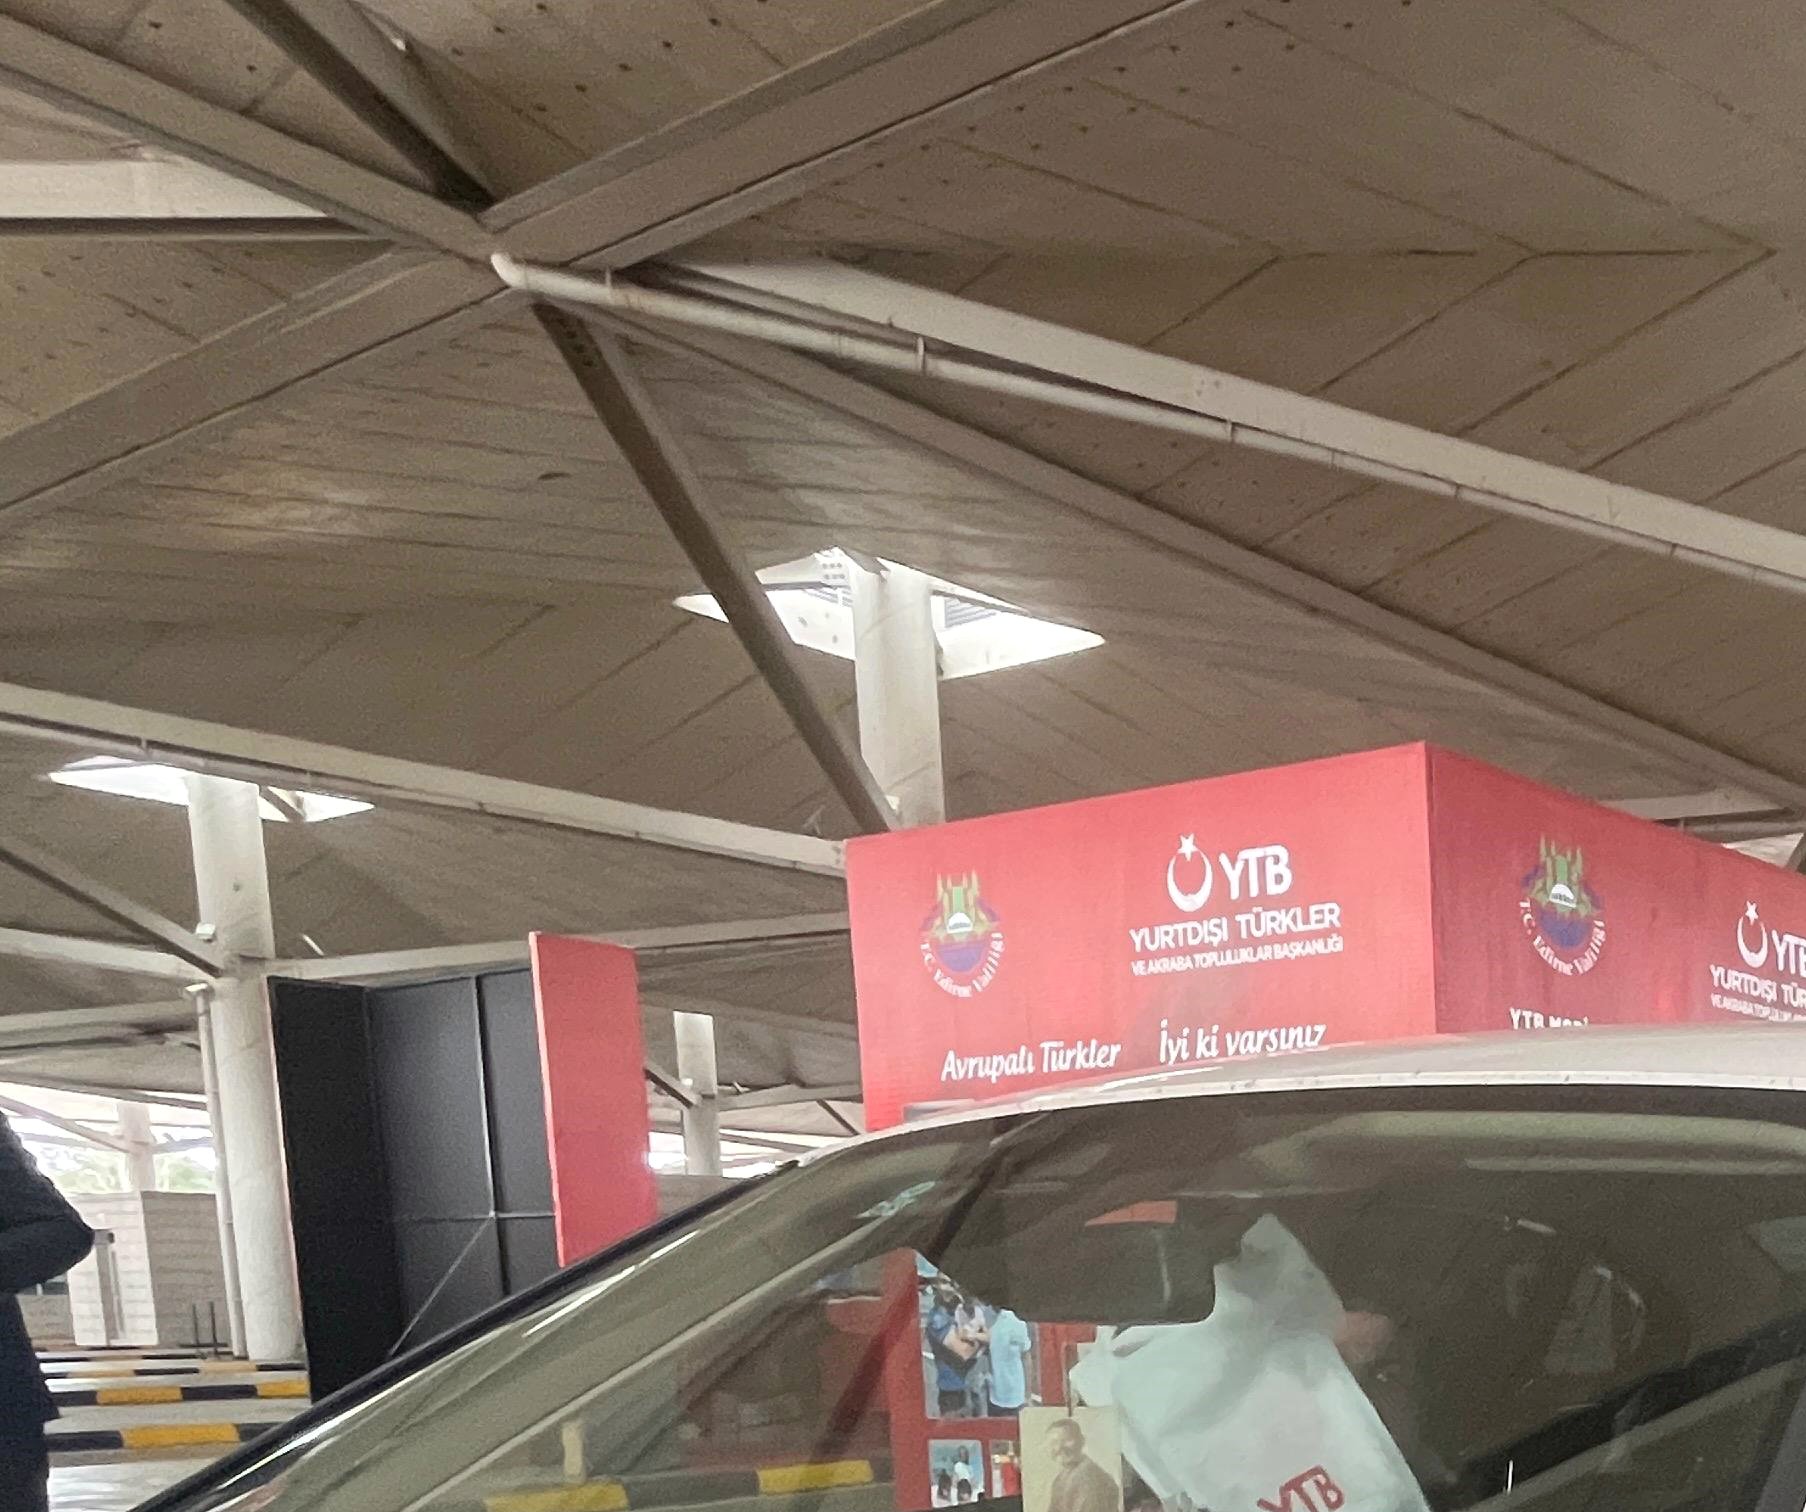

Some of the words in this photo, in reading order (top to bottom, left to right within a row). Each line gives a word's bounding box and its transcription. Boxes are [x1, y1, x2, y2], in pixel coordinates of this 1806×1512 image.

[1218, 844, 1292, 900] YTB
[1129, 916, 1229, 952] YURTDIŞI
[1235, 902, 1342, 939] TÜRKLER
[1709, 964, 1778, 1003] YURTDIŞI
[940, 1045, 1035, 1084] Avrupalı
[1159, 1018, 1190, 1065] İyi
[1195, 1024, 1219, 1060] ki
[1225, 1024, 1327, 1057] varsınız
